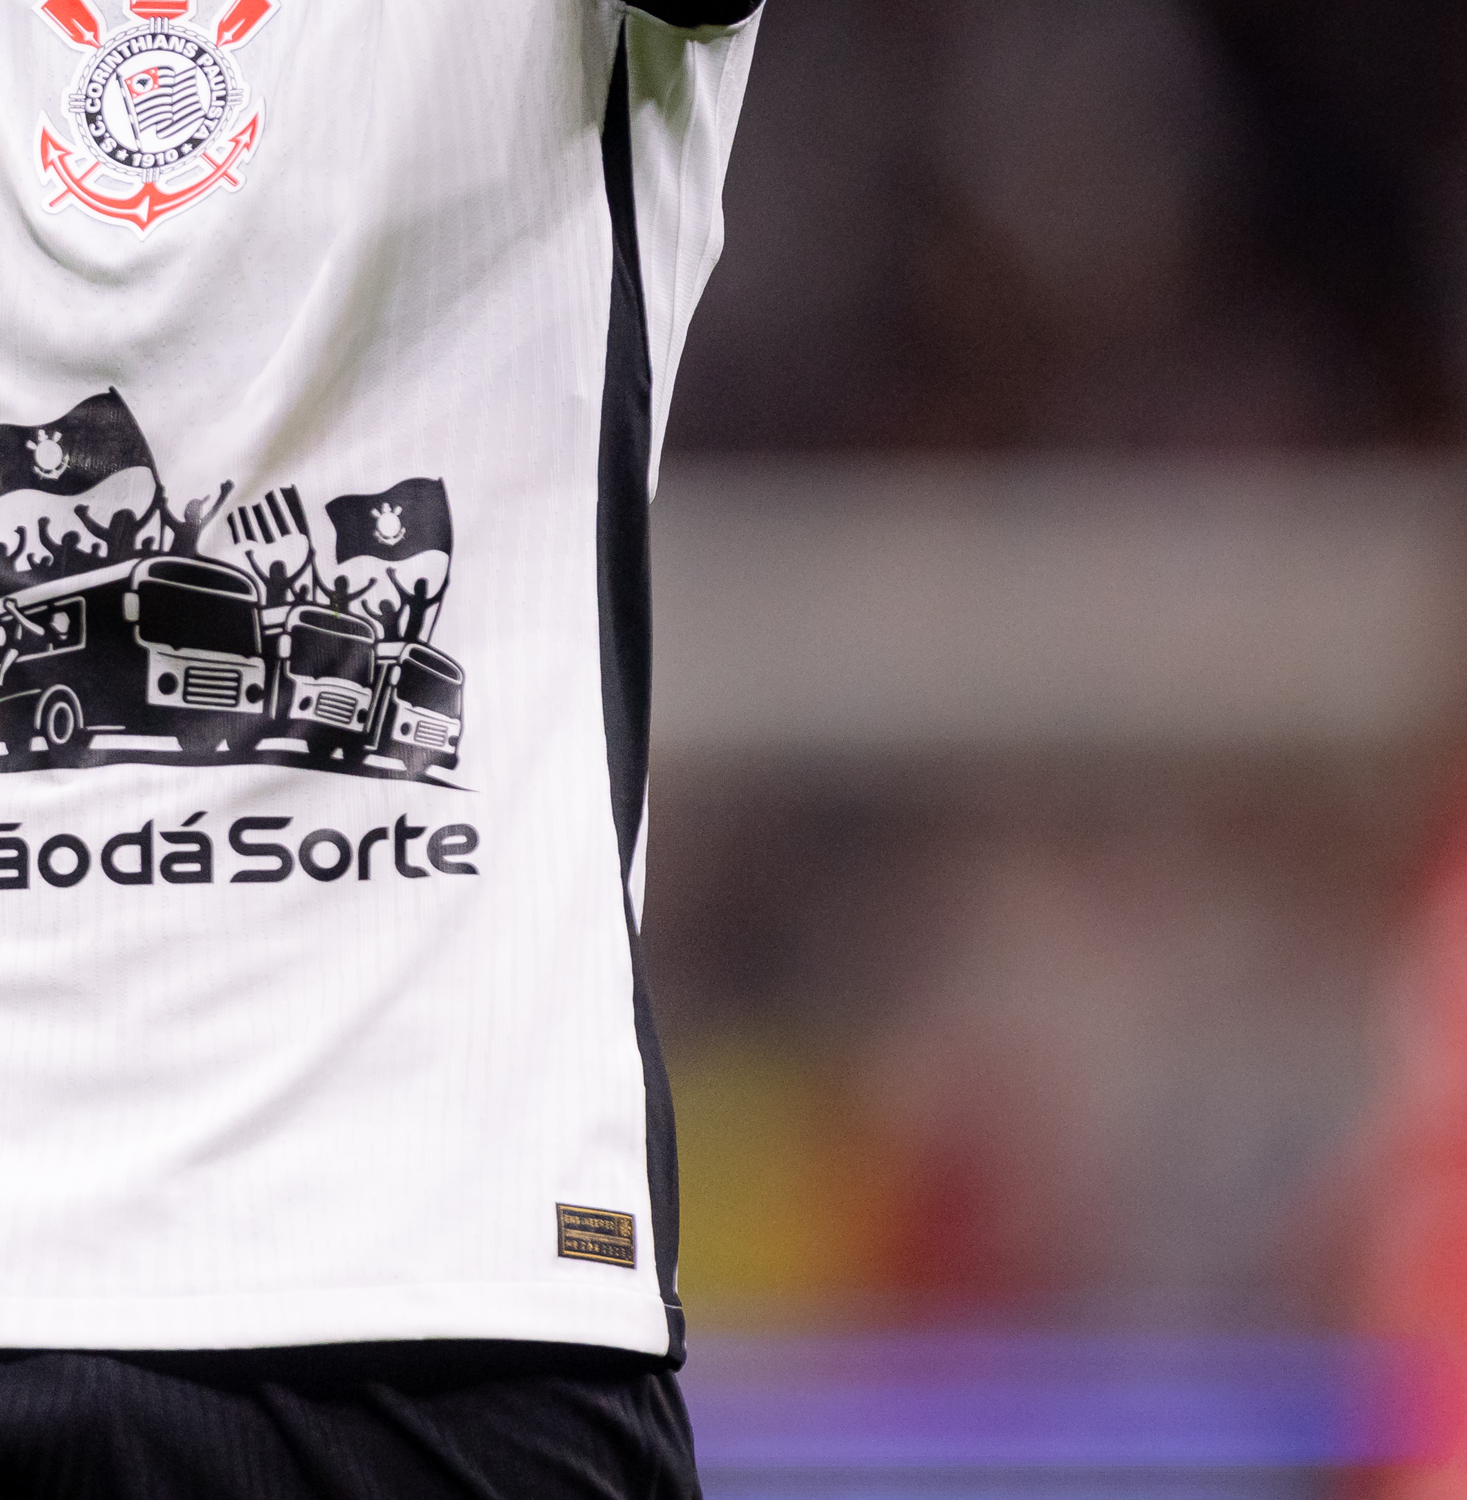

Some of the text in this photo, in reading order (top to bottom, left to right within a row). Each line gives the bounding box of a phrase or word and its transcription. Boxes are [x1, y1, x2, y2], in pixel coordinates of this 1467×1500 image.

[85, 34, 200, 114] CORINTHIANS
[193, 53, 227, 141] PAULISTA
[132, 148, 180, 168] 1910
[228, 813, 480, 884] Sorte
